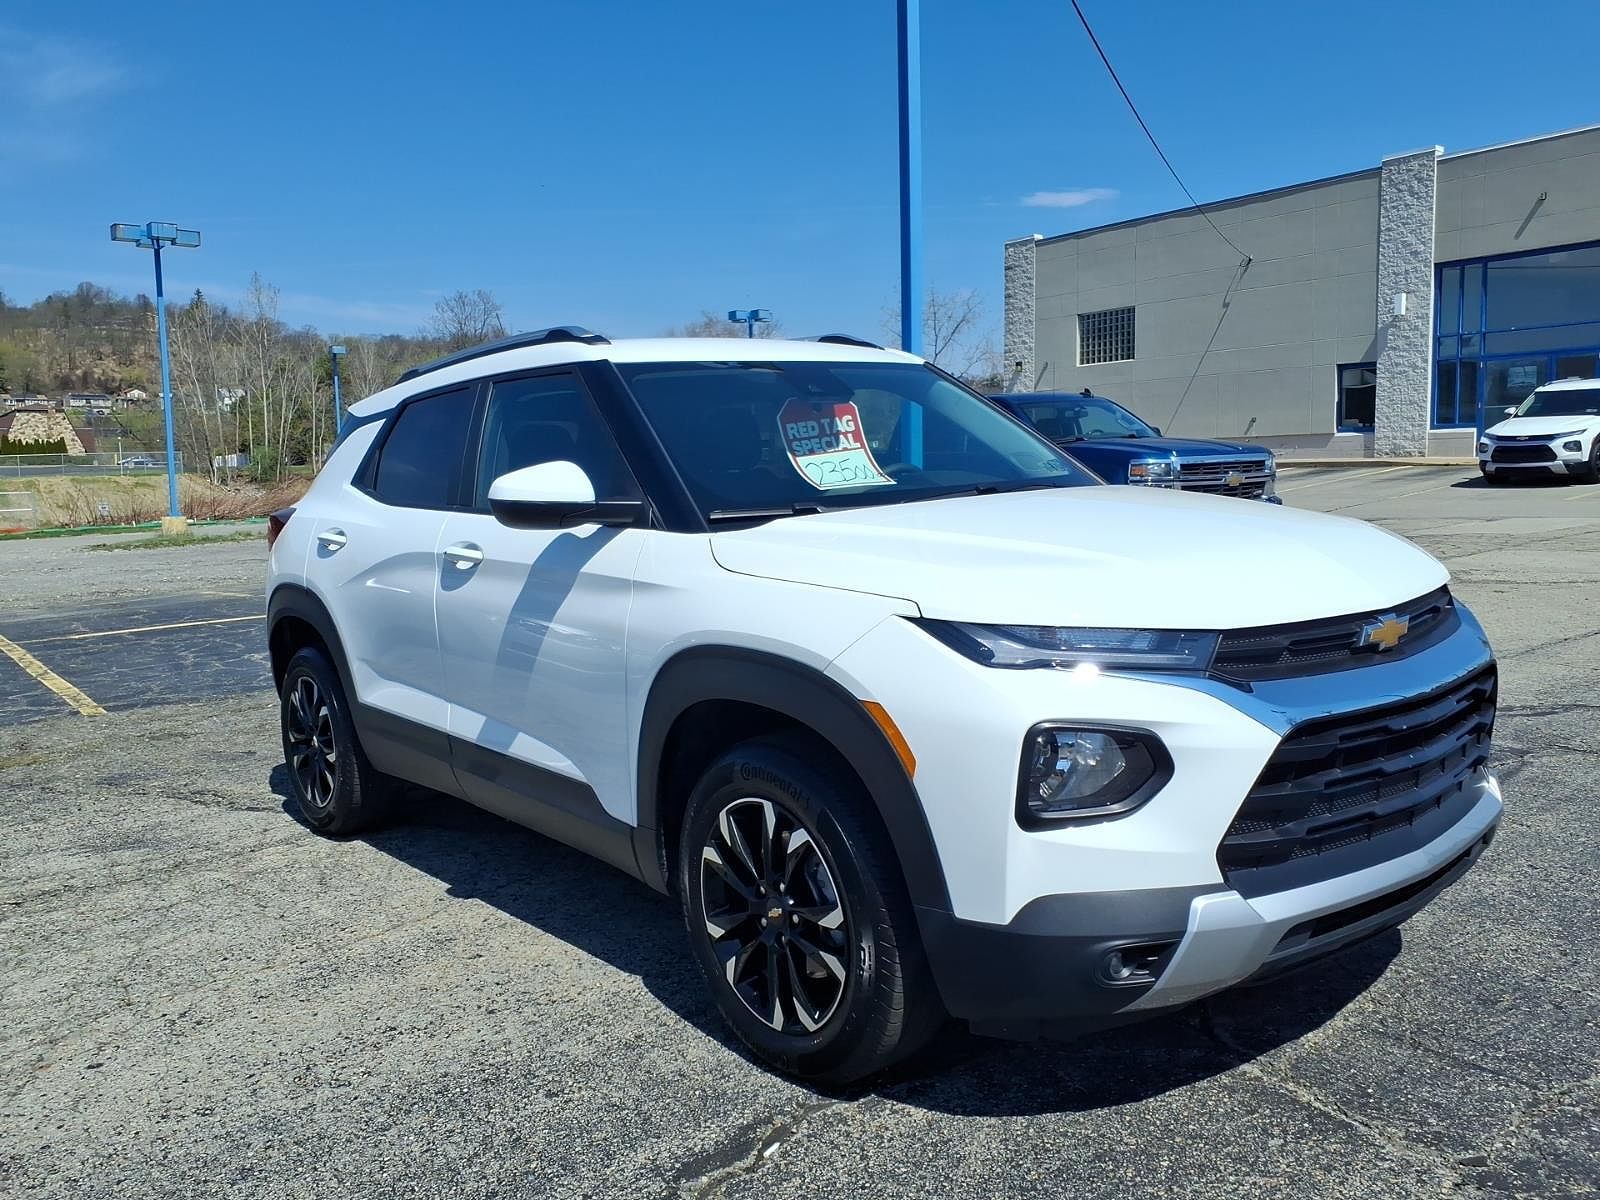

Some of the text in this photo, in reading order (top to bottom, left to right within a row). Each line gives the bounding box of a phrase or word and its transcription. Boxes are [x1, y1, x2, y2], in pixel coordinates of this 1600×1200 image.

[786, 415, 856, 440] RED TAG
[792, 433, 861, 455] SPECIAL
